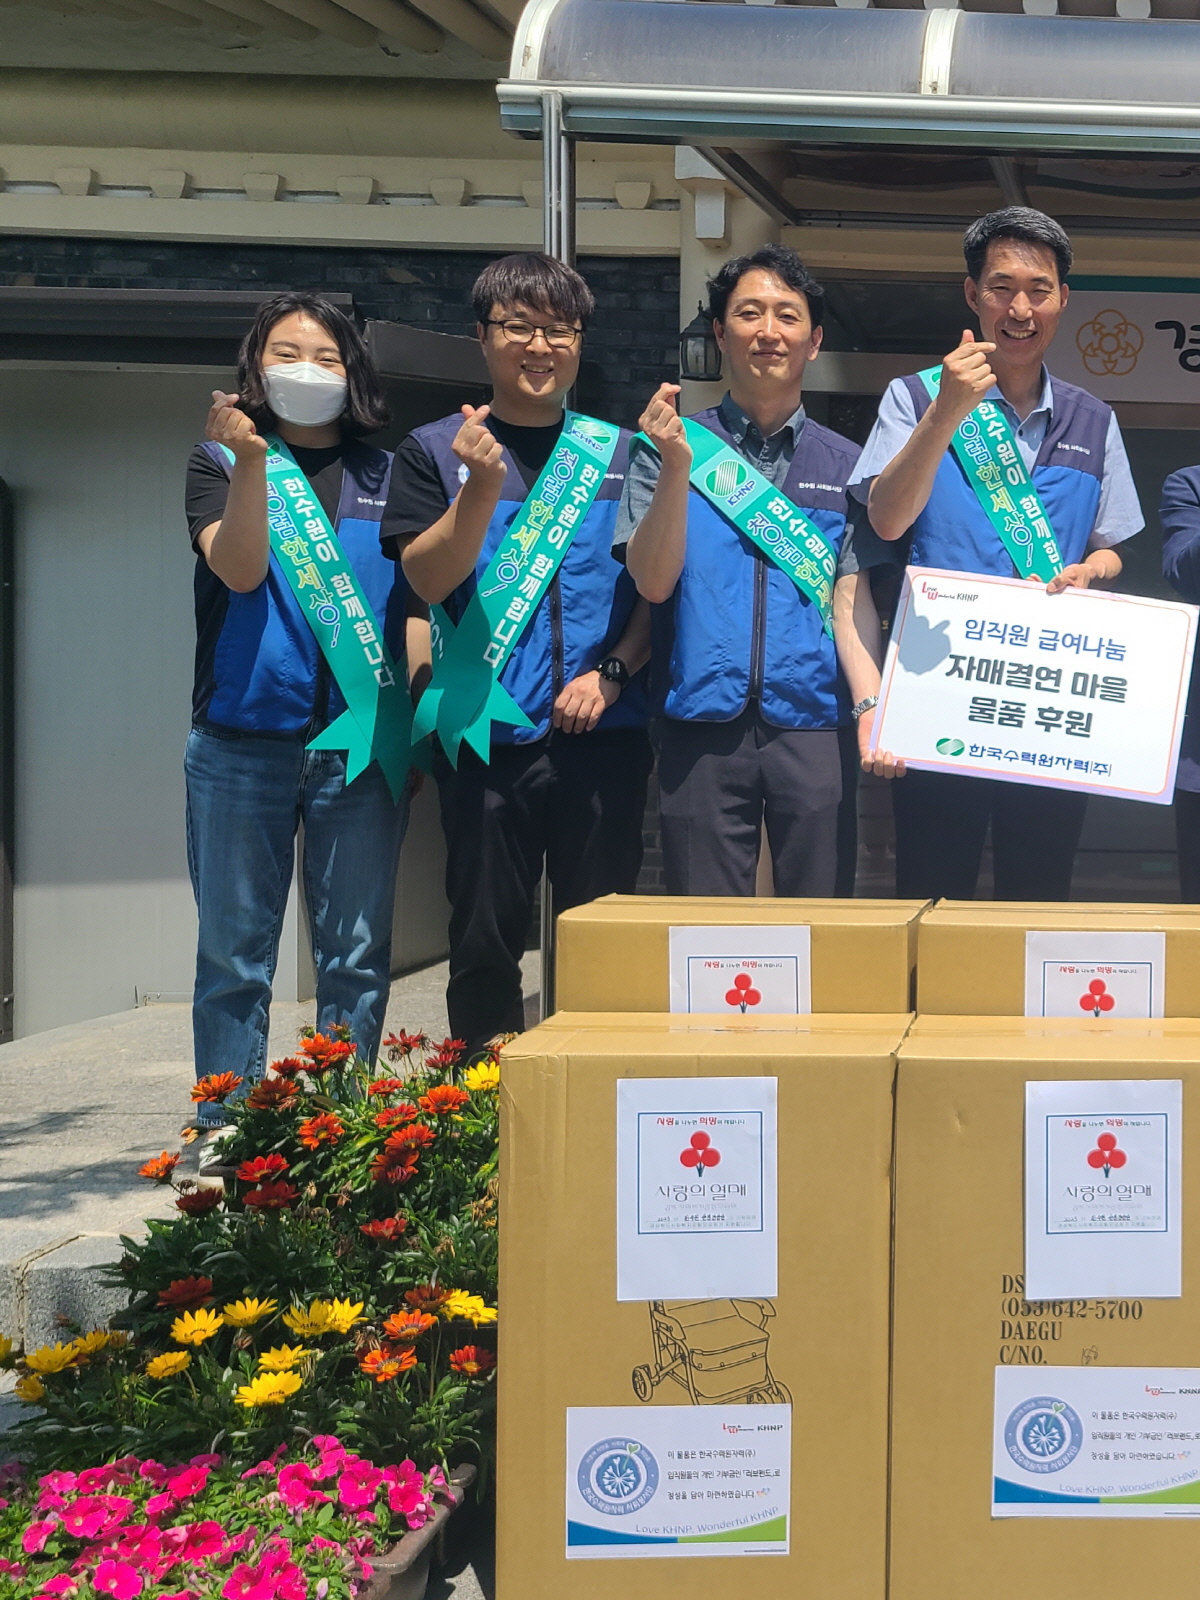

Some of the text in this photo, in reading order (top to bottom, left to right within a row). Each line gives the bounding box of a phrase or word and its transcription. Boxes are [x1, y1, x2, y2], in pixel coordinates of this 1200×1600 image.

[571, 429, 604, 452] KHNP
[977, 401, 1026, 485] 한수원이
[266, 457, 283, 466] NP
[726, 480, 756, 507] KHNP
[481, 447, 578, 597] 청렴한세상!
[767, 497, 836, 577] 한수원이
[483, 463, 599, 668] 한수원이 함께합니다
[282, 477, 395, 688] 한수원이 함께합니다
[956, 593, 979, 602] KHNP
[964, 619, 1127, 661] 임직원 급여나눔
[946, 653, 1129, 704] 자매결연 마을
[967, 696, 1094, 739] 물품 후원
[968, 743, 1112, 778] 한국수력원자력(주)
[656, 1183, 747, 1203] 사랑의 열매
[1064, 1184, 1152, 1202] 사랑의 열매
[1001, 1297, 1143, 1320] (053)642-5700
[1000, 1320, 1063, 1340] DAEGU
[1000, 1345, 1047, 1364] C/NO.
[1101, 1412, 1120, 1421] 물품은
[1122, 1411, 1178, 1421] 한국수력원자력(주)
[1092, 1431, 1122, 1441] 임직원들의
[1124, 1431, 1137, 1440] 개인
[1139, 1432, 1162, 1441] 기부금인
[677, 1451, 697, 1460] 물품은
[699, 1450, 756, 1458] 한국수력원자력(주)
[1091, 1451, 1110, 1461] 정성을
[1113, 1451, 1127, 1461] 담아
[668, 1471, 699, 1480] 임직원들의
[702, 1470, 714, 1479] 개인
[717, 1470, 741, 1479] 기부금인
[1060, 1483, 1083, 1494] Love
[1120, 1477, 1169, 1494] Wonderful
[1171, 1468, 1199, 1484] KHNP
[667, 1491, 687, 1500] 정성을
[690, 1491, 704, 1500] 담아
[635, 1524, 660, 1534] Love
[698, 1517, 748, 1532] Wonderful
[751, 1506, 779, 1521] KHNP
